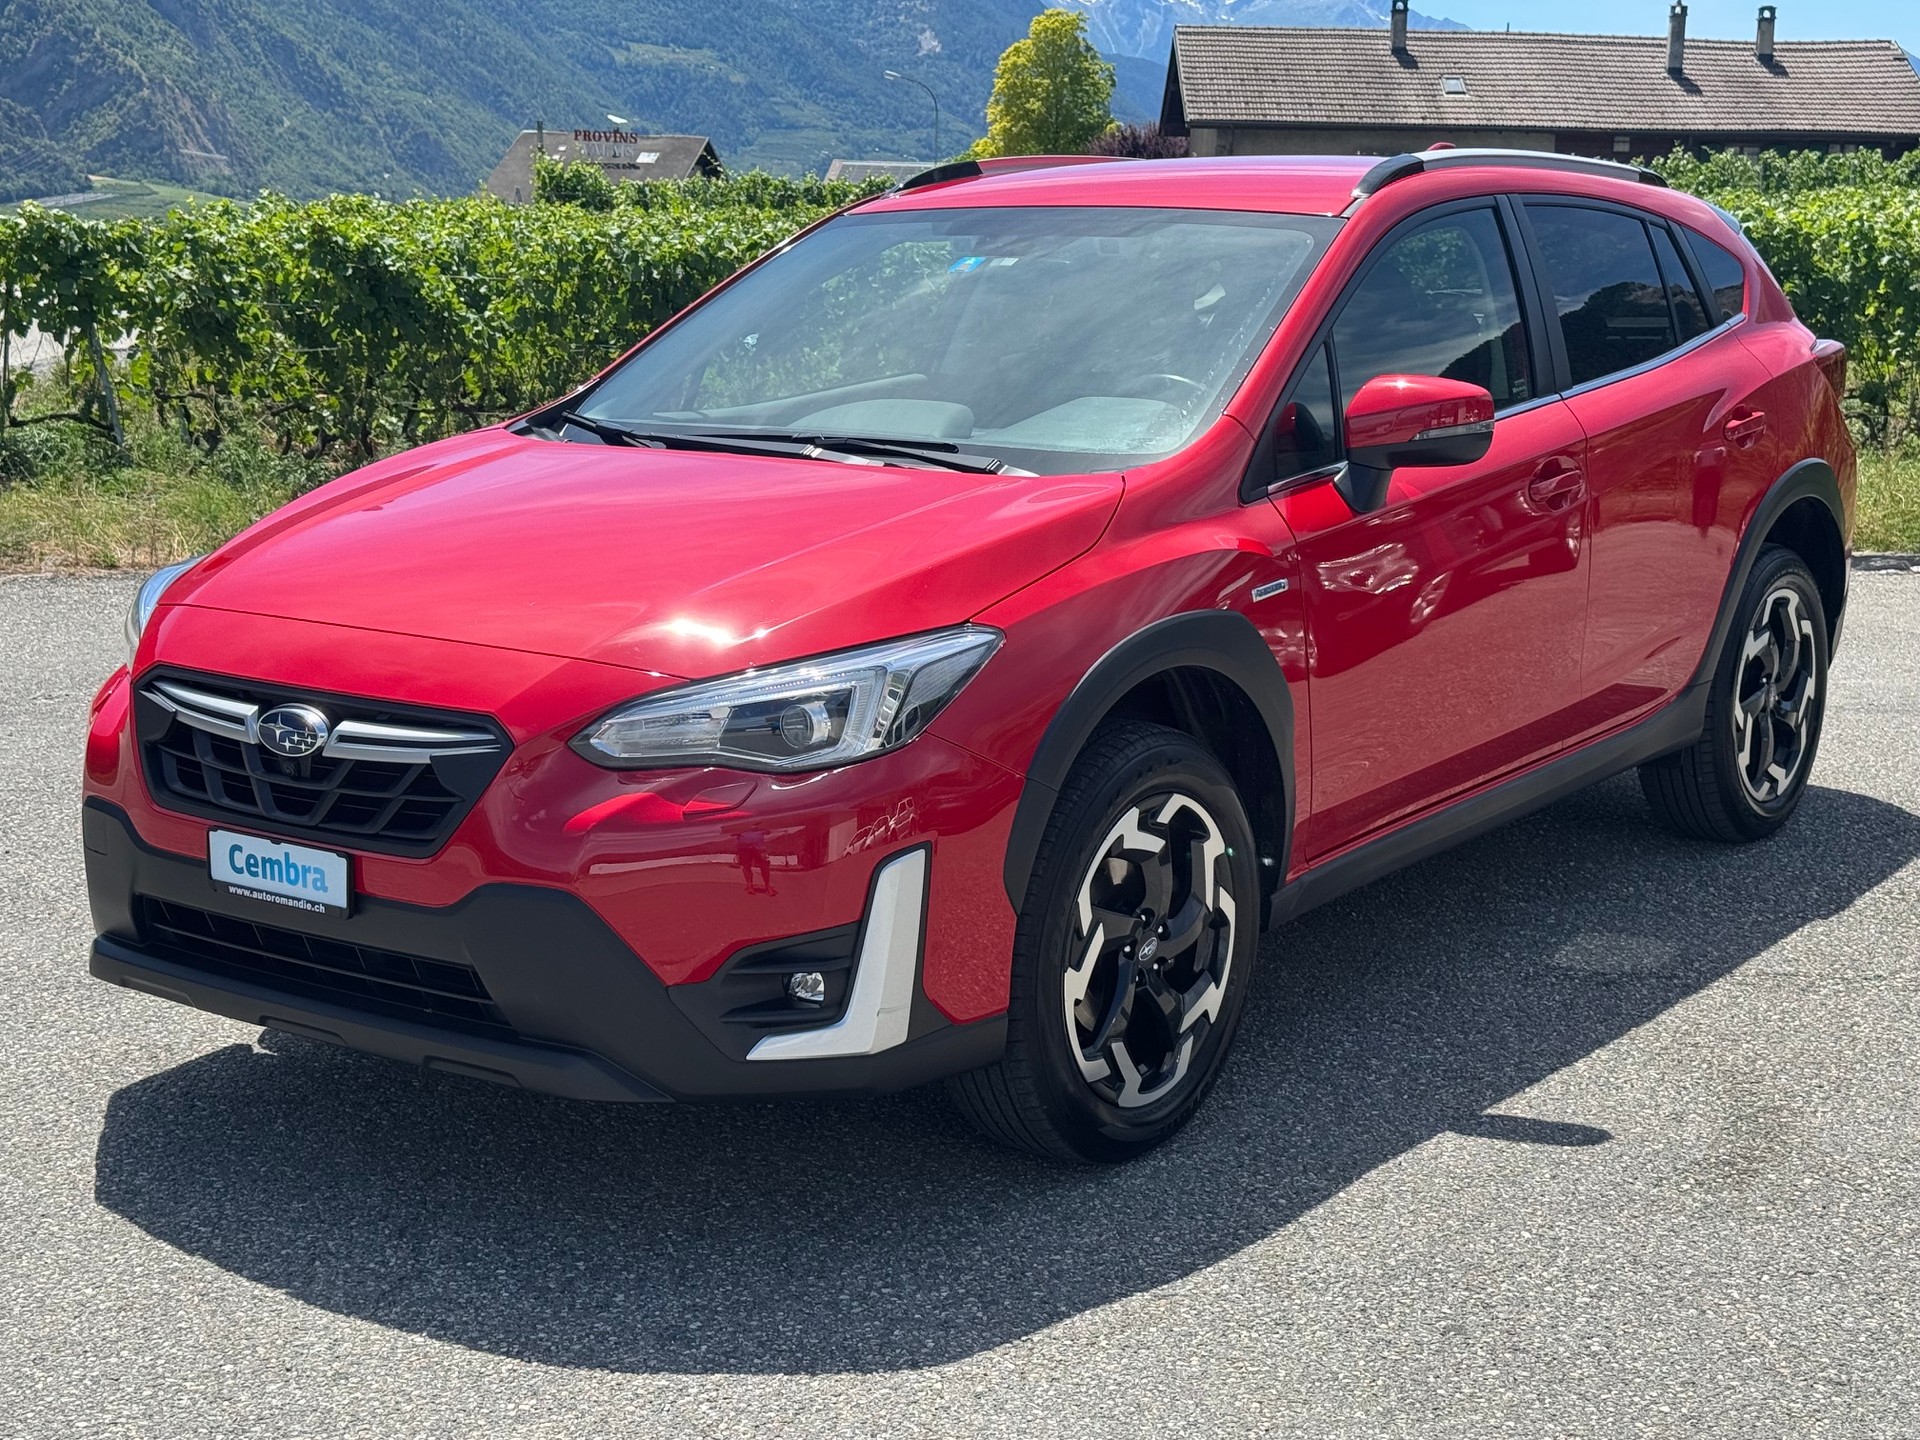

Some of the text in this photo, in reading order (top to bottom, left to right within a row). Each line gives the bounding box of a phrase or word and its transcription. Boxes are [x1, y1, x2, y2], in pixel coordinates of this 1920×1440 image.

[574, 129, 638, 144] PROVINS
[228, 843, 328, 893] Cembra
[228, 885, 326, 914] www.autoromandie.ch
